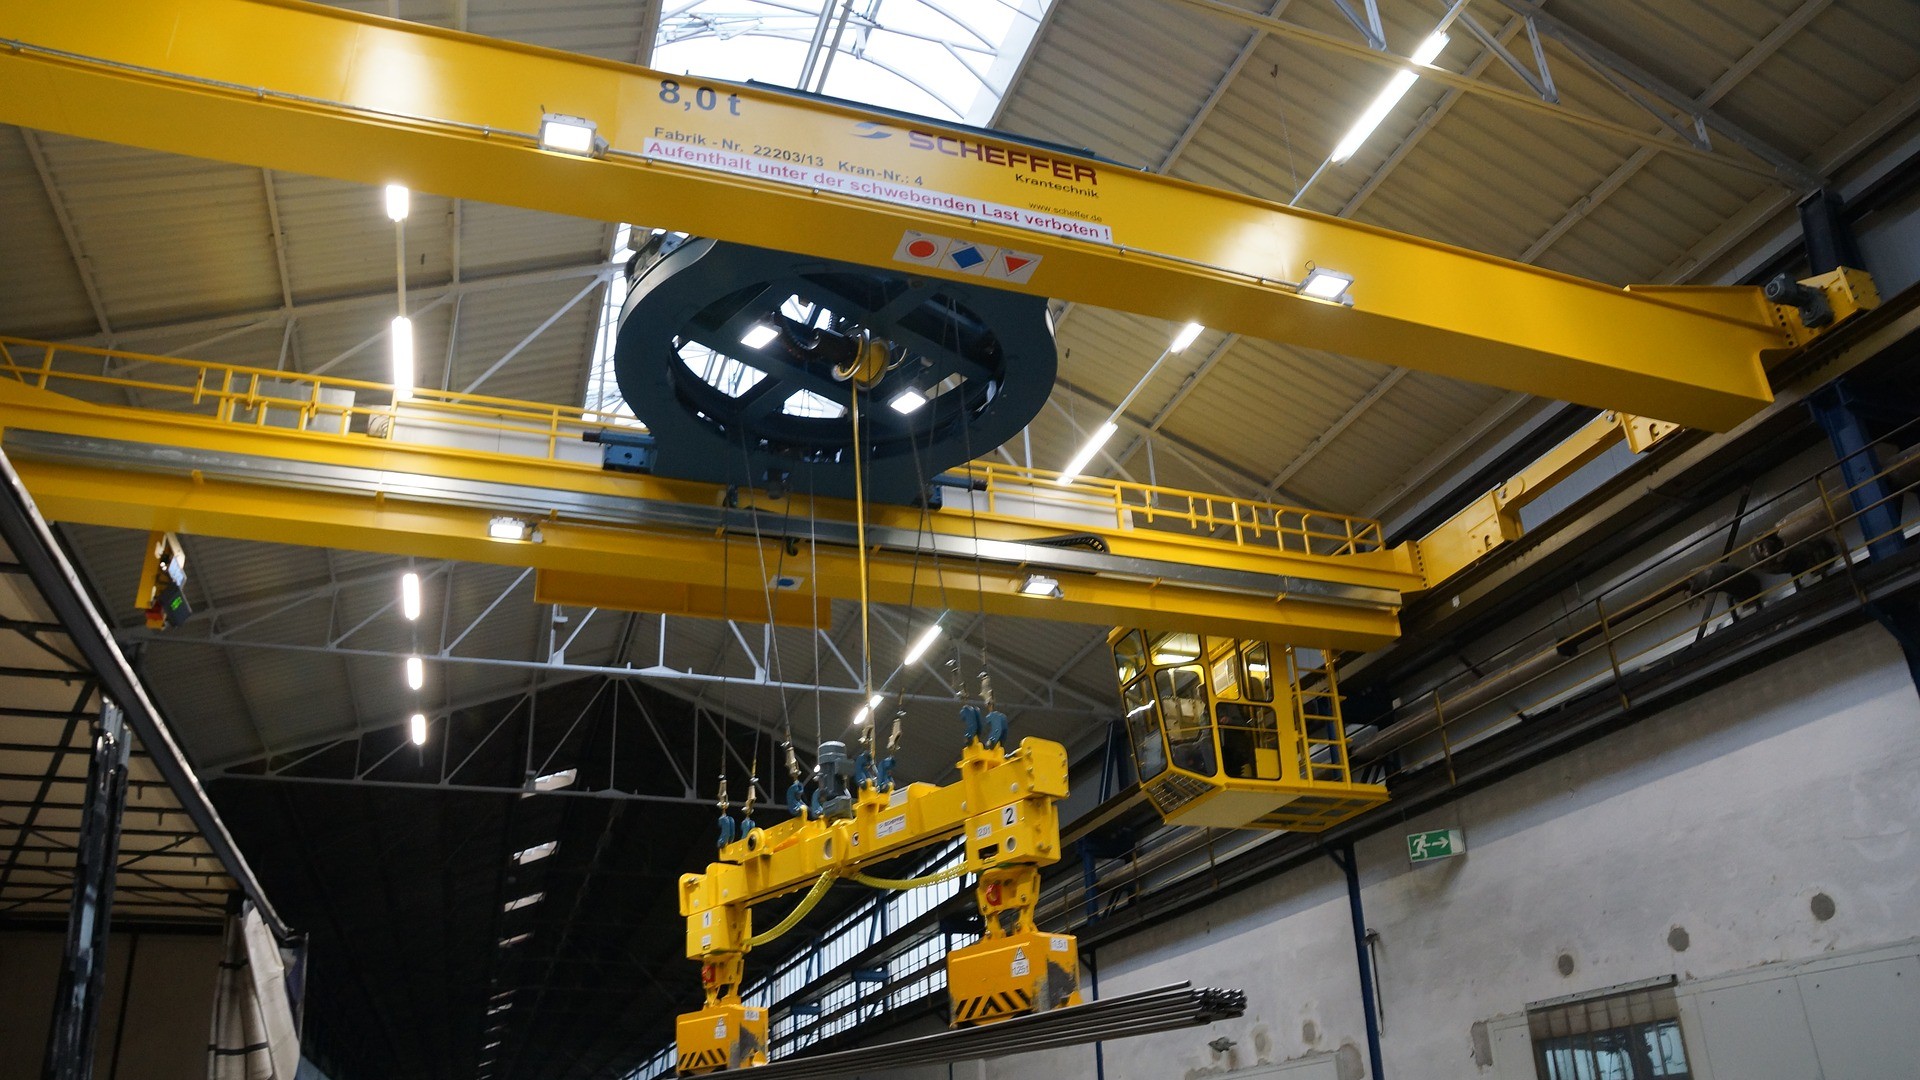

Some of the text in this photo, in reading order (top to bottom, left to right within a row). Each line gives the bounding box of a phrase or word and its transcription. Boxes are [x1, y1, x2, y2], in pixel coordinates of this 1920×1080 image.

[658, 79, 741, 116] 8,0 t
[654, 127, 706, 146] Fabrik
[722, 139, 744, 152] Nr.
[753, 144, 824, 168] 22203/13
[914, 175, 923, 186] 4
[908, 130, 1098, 186] SCHEFFER
[648, 142, 1109, 240] Aufenthalt unter der schwebenden Last verboten !
[1015, 173, 1099, 198] Krantechnik
[1028, 201, 1103, 223] www.scheffer.de
[1005, 807, 1014, 825] 2
[705, 912, 709, 926] 1
